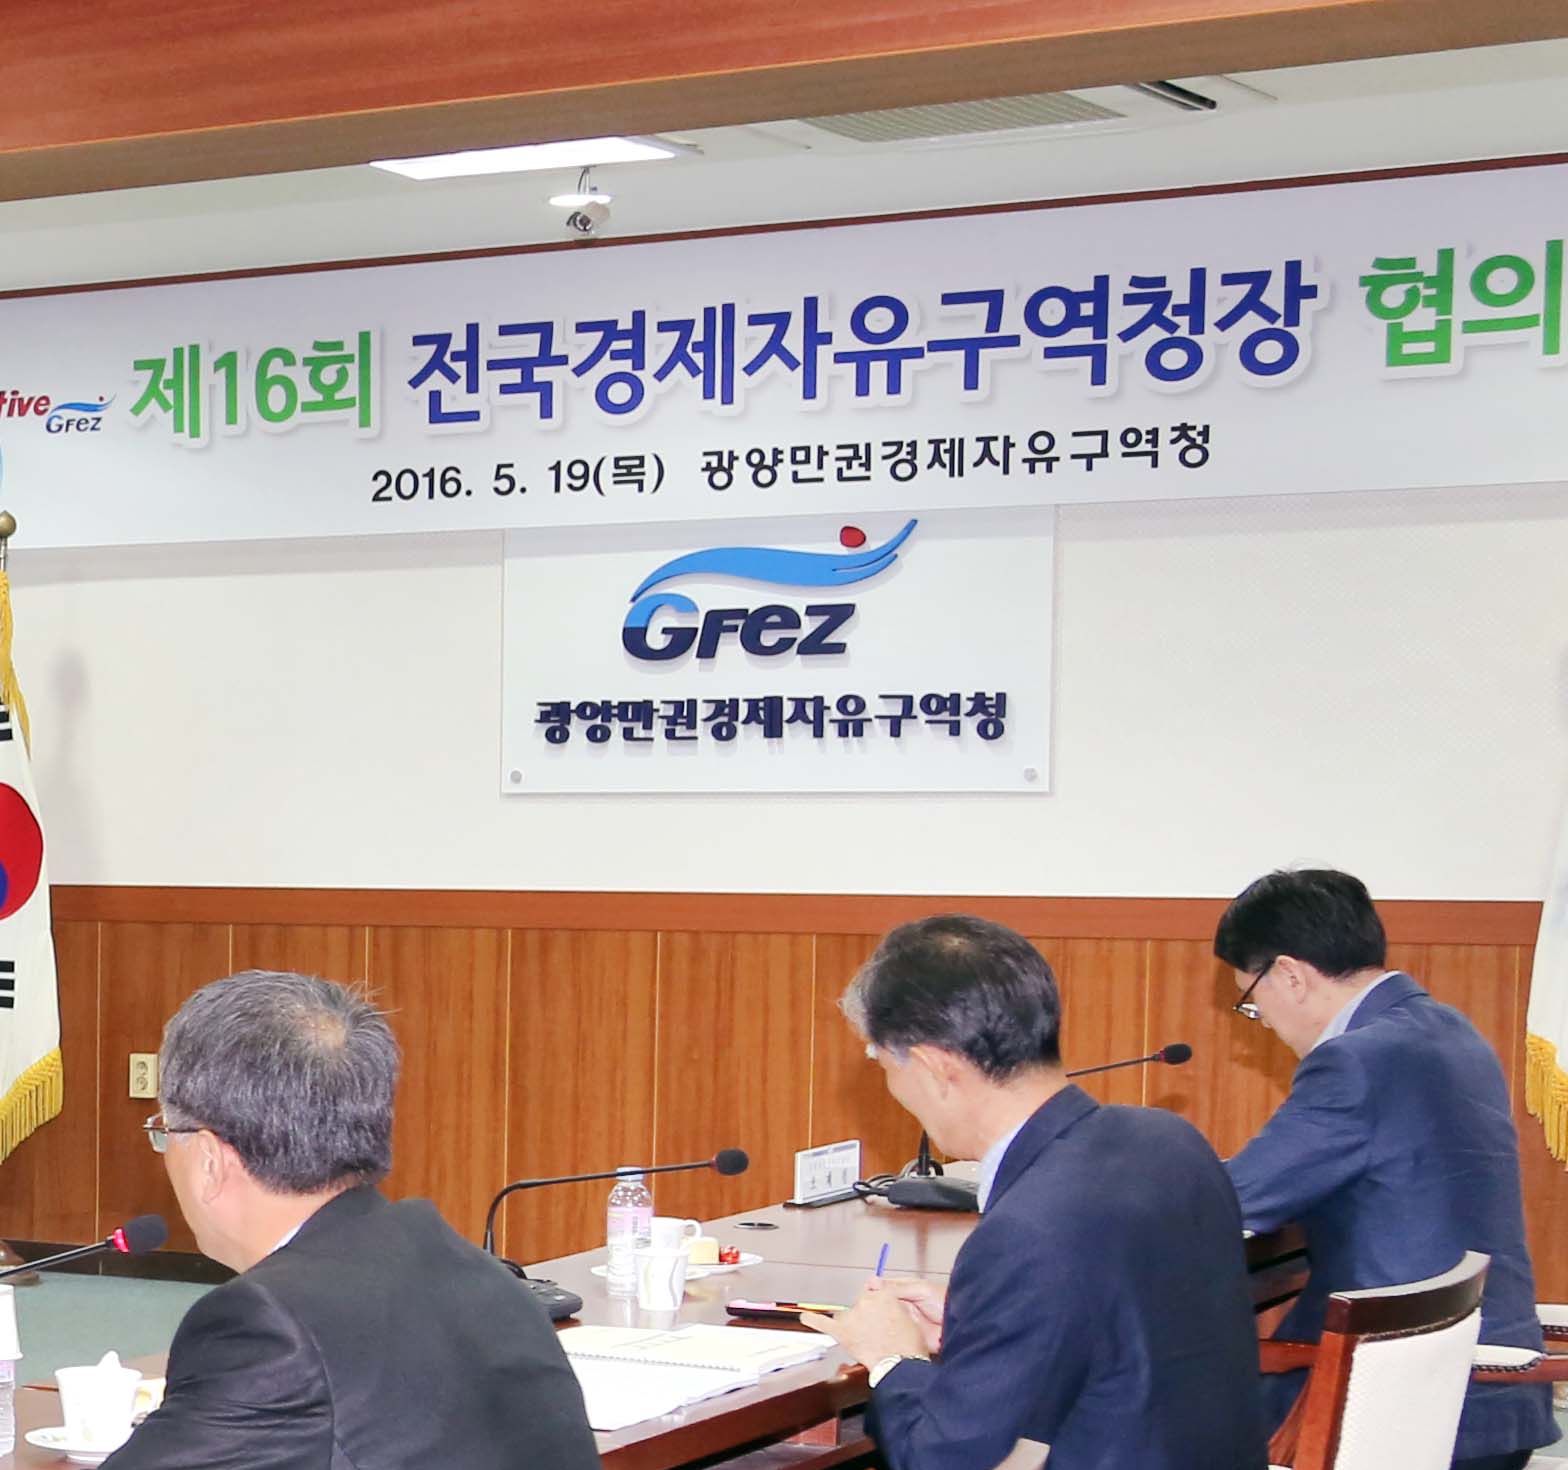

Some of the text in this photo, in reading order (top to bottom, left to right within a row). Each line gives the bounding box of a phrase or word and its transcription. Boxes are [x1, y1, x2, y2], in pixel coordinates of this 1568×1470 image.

[130, 238, 1565, 439] 제16회 전국경제자유구역청장 협의
[371, 422, 1212, 502] 2016. 5. 19(목) 광양만권경제자유구역청
[533, 691, 1008, 744] 광양만권경제자유구역청
